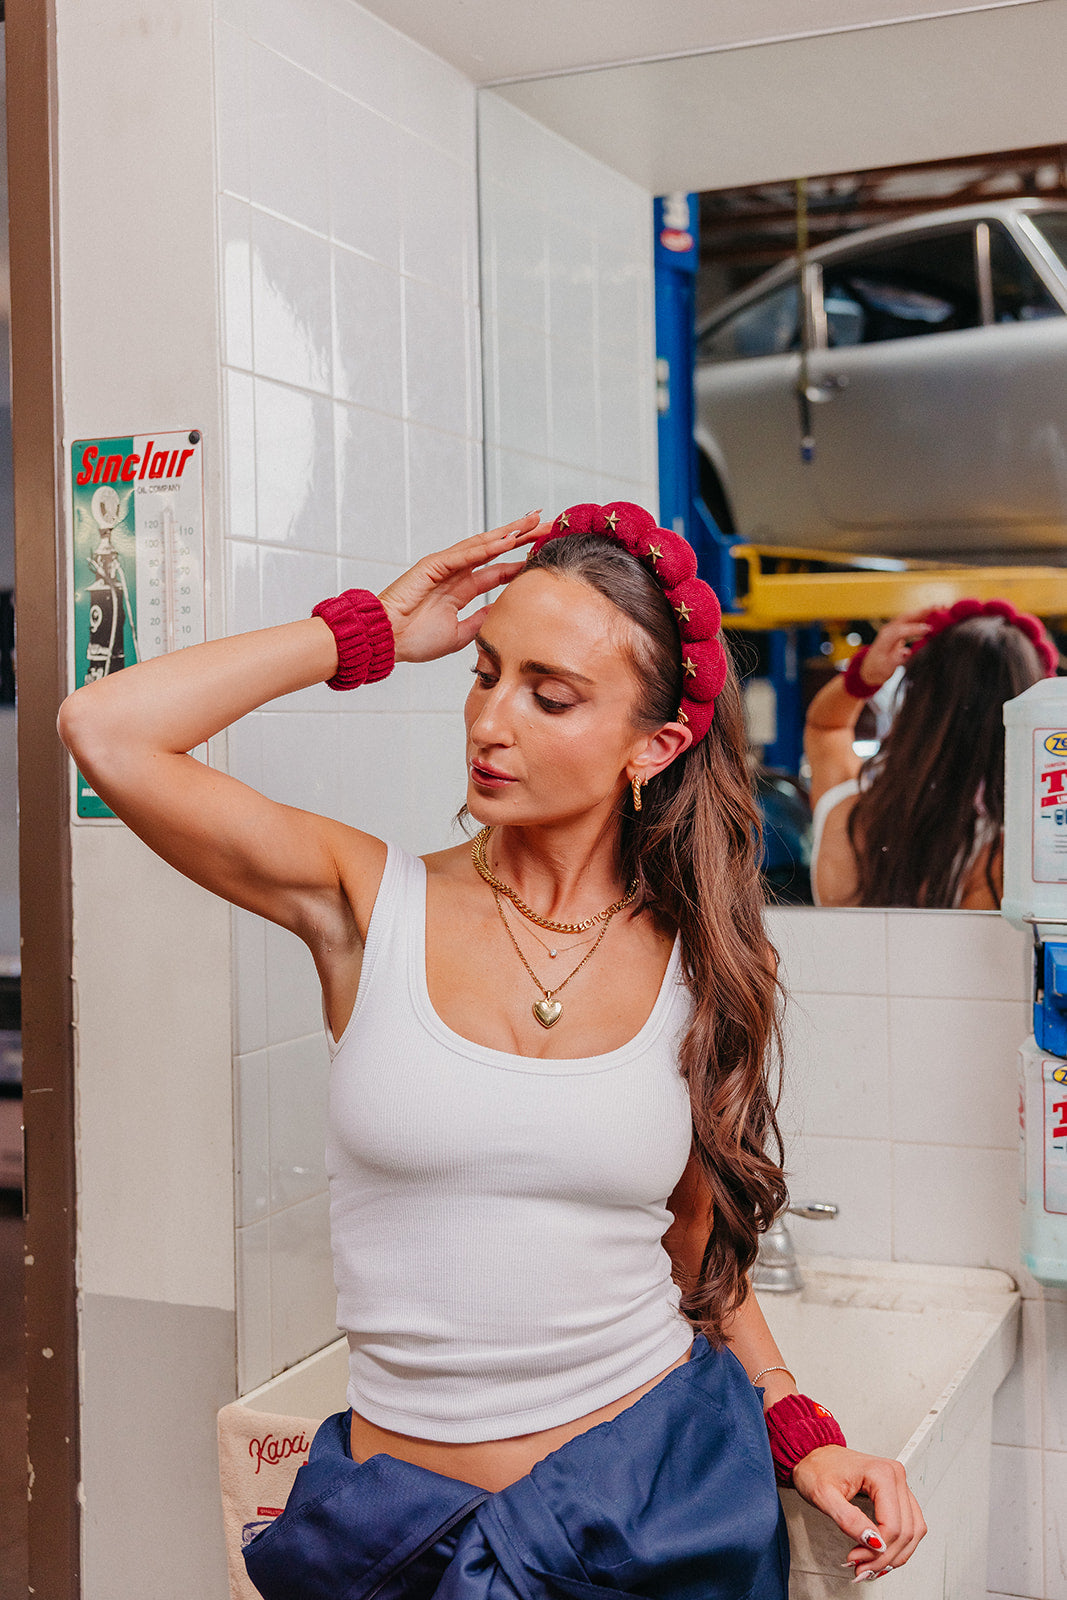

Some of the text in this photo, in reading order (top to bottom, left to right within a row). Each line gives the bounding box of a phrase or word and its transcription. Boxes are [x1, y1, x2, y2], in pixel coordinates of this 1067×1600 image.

[76, 441, 195, 485] Sinclair
[149, 483, 181, 493] COMPANY
[144, 520, 159, 529] 120
[180, 525, 194, 535] 110
[149, 578, 160, 587] 60
[180, 586, 191, 595] 50
[149, 598, 160, 606] 40
[180, 606, 191, 615] 30
[150, 617, 161, 626] 20
[182, 625, 192, 634] 10
[155, 636, 161, 645] 0
